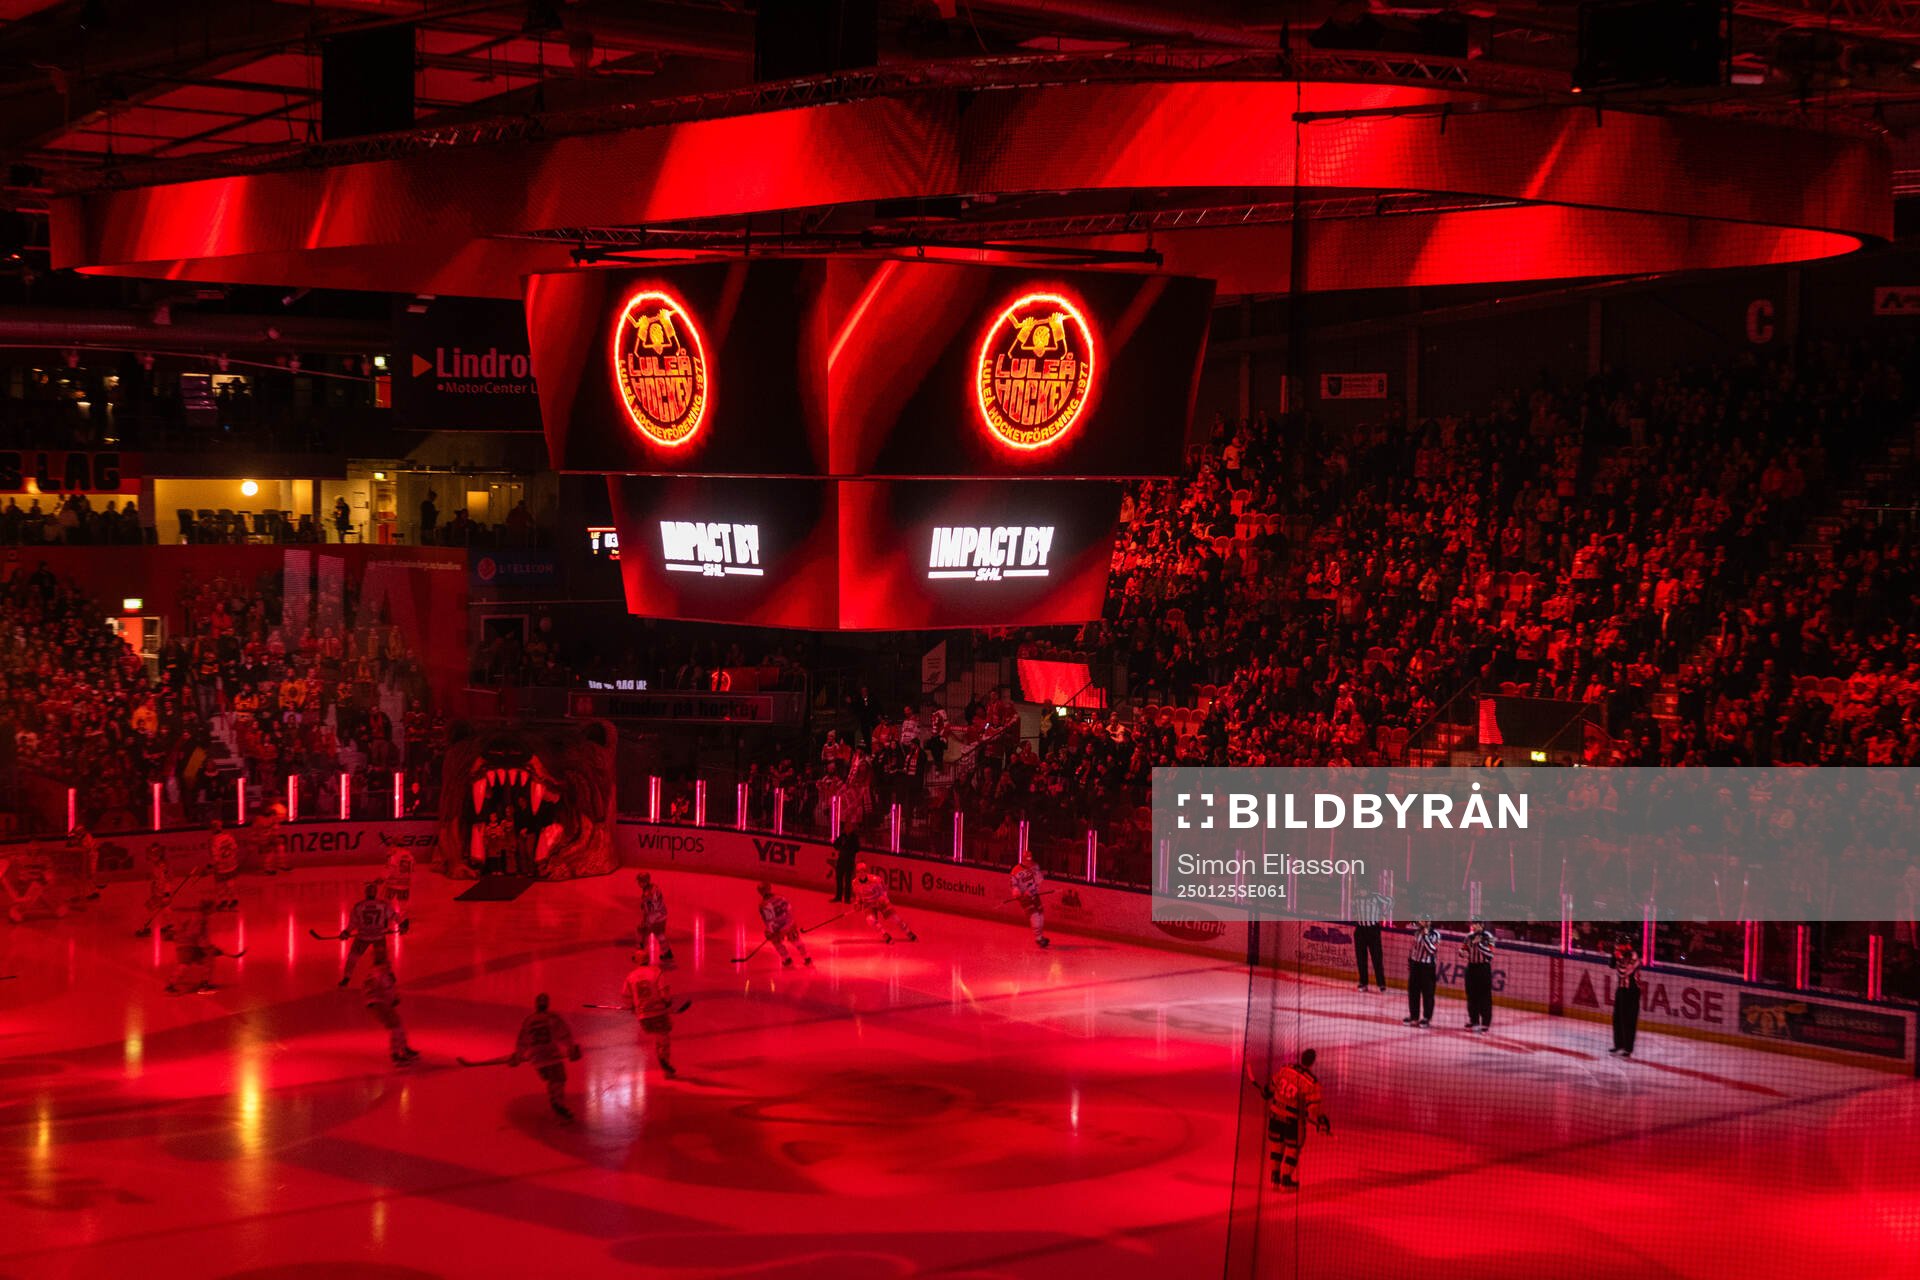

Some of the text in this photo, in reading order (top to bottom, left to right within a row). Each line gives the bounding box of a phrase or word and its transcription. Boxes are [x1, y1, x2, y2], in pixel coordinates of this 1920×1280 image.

[627, 348, 692, 376] LULEÅ
[995, 352, 1076, 379] LULEÅ
[445, 381, 528, 395] MotorCenter
[631, 377, 693, 423] HOCKEY
[995, 379, 1074, 425] HOCKEY
[988, 398, 1081, 442] HOCKEYFÖRENING
[732, 524, 760, 564] BY
[929, 527, 1055, 567] IMPACT BY
[975, 567, 1002, 581] SHL
